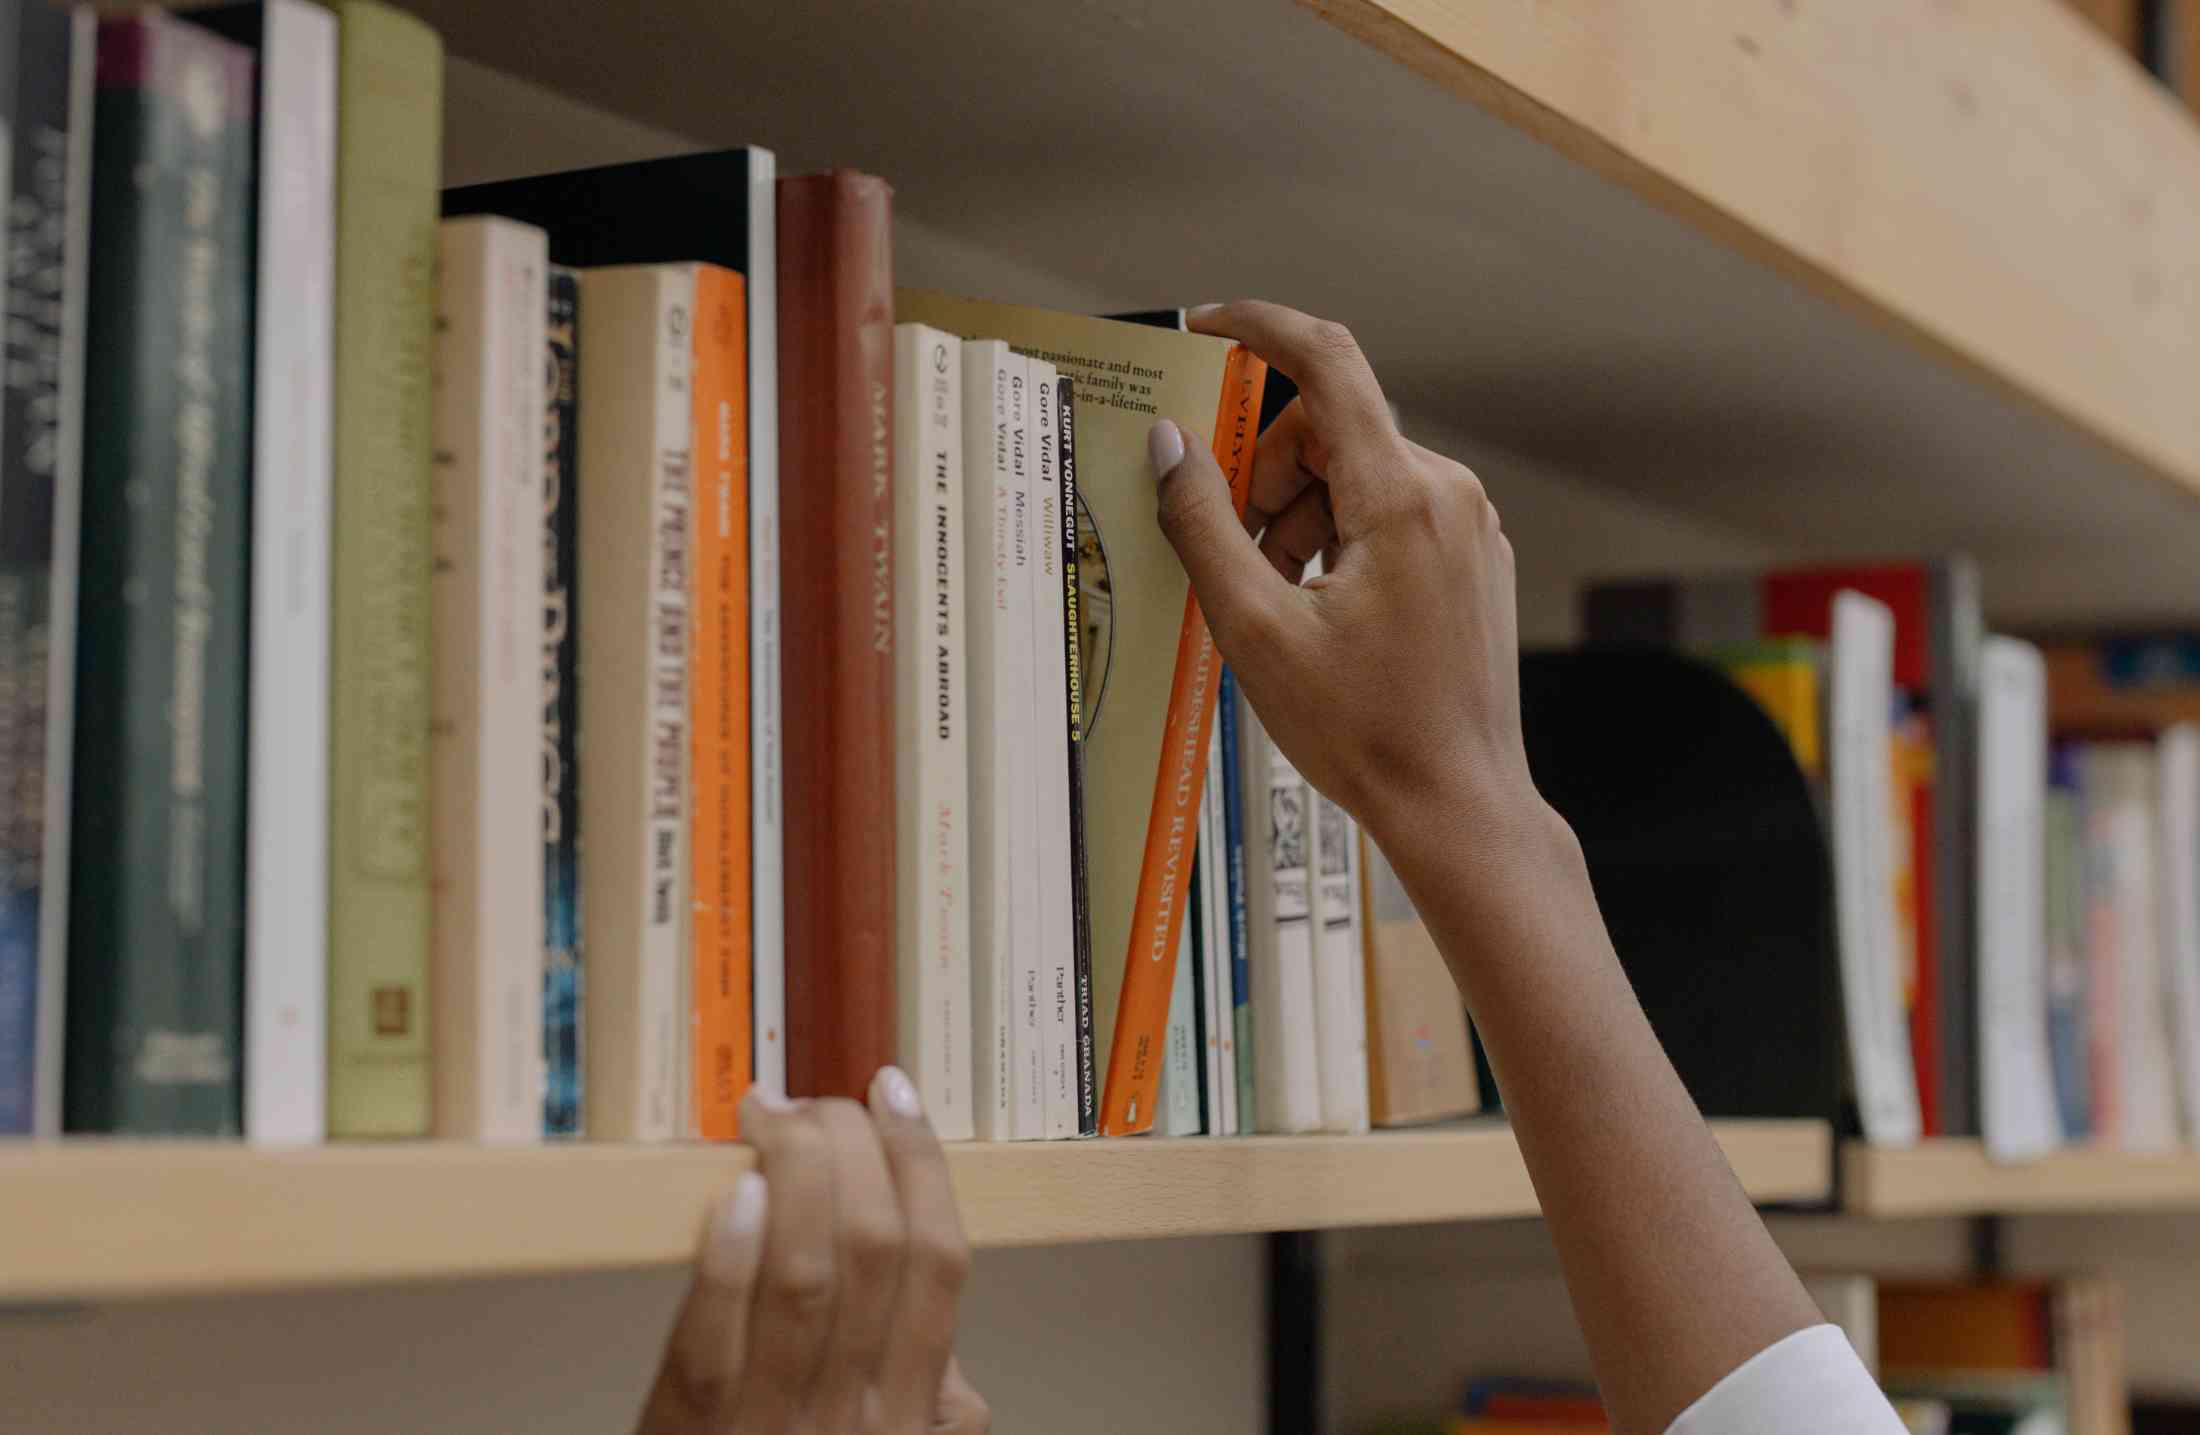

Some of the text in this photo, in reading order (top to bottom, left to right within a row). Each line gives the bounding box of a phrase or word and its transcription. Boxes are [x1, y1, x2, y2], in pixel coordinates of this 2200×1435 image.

[996, 368, 1007, 415] Gore
[1040, 351, 1105, 371] passionate
[1105, 359, 1130, 374] and
[1132, 366, 1164, 381] most
[1086, 370, 1125, 391] family
[1129, 382, 1152, 396] was
[719, 401, 732, 461] MARK
[997, 423, 1007, 471] Vidal
[1011, 376, 1027, 567] Gore Vidal Messiah
[1039, 382, 1055, 576] Gore Vidal Williwaw
[719, 470, 732, 537] TWAIN
[872, 380, 891, 656] MARK TWAIN
[936, 450, 951, 741] THE INNOCENTS ABROAD
[1062, 404, 1080, 741] KURT VONNEGUT SLAUGHTERHOUSE 5
[1151, 815, 1185, 962] REVISITED
[1055, 966, 1066, 1024] Panther
[1080, 974, 1092, 1117] TRIAD GRANADA
